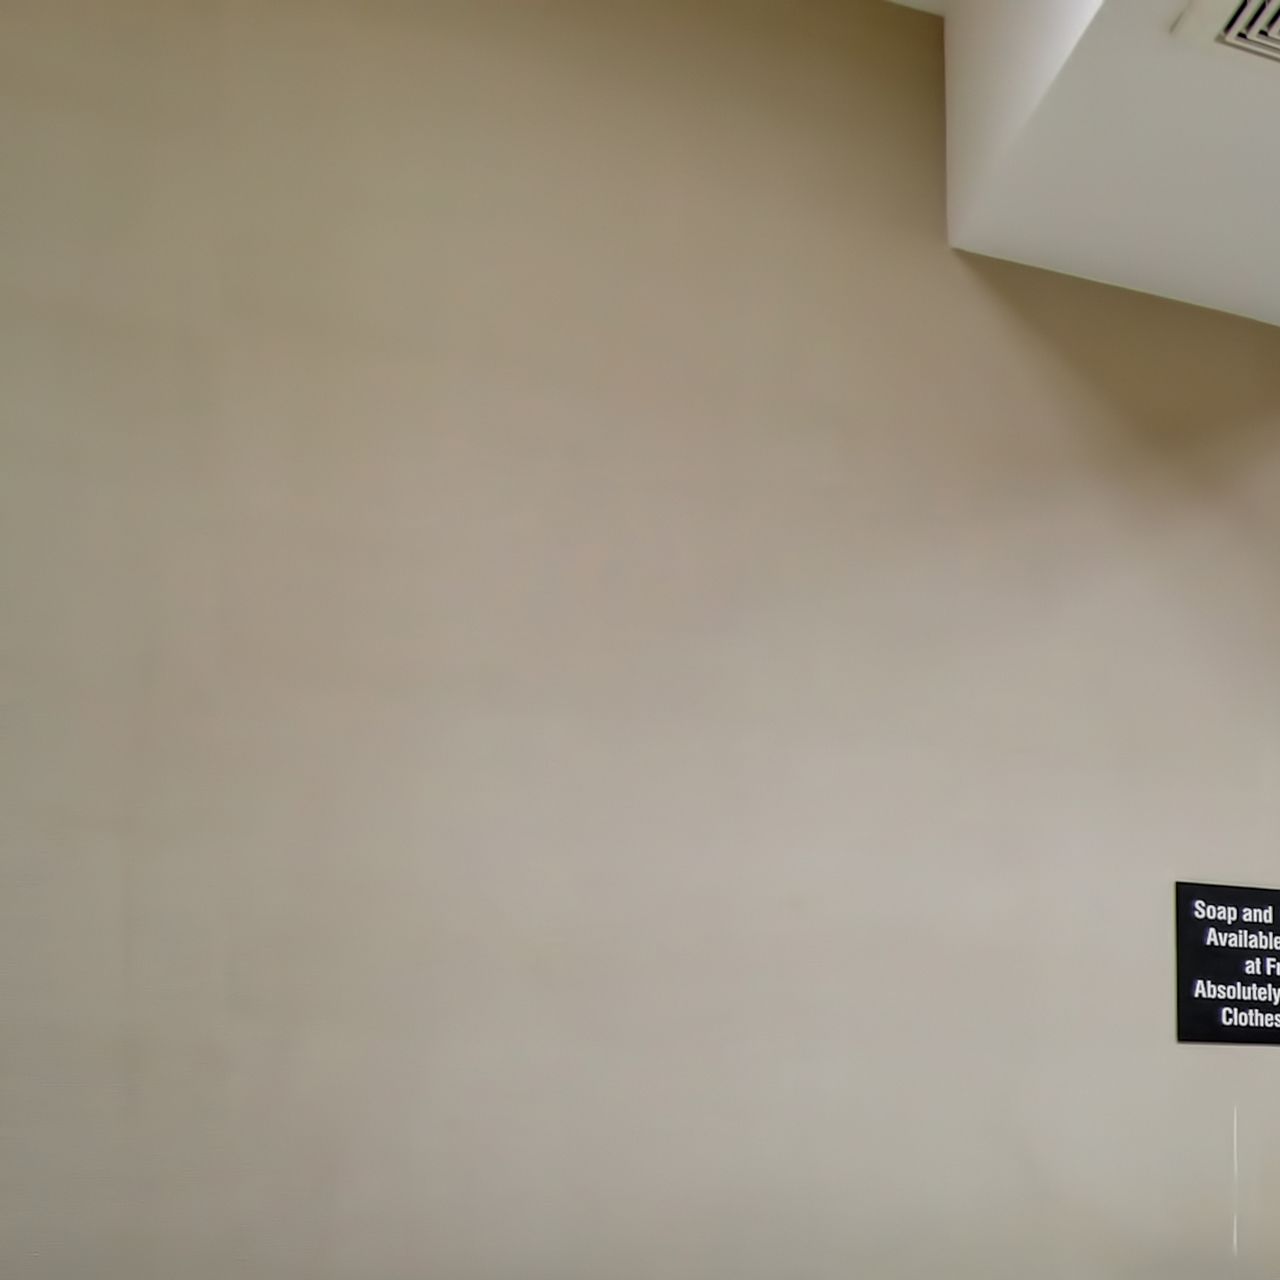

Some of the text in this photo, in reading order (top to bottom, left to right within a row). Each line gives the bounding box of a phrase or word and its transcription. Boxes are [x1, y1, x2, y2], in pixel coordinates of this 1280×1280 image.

[1193, 899, 1238, 925] Soap
[1241, 905, 1273, 924] and
[1244, 957, 1262, 976] at
